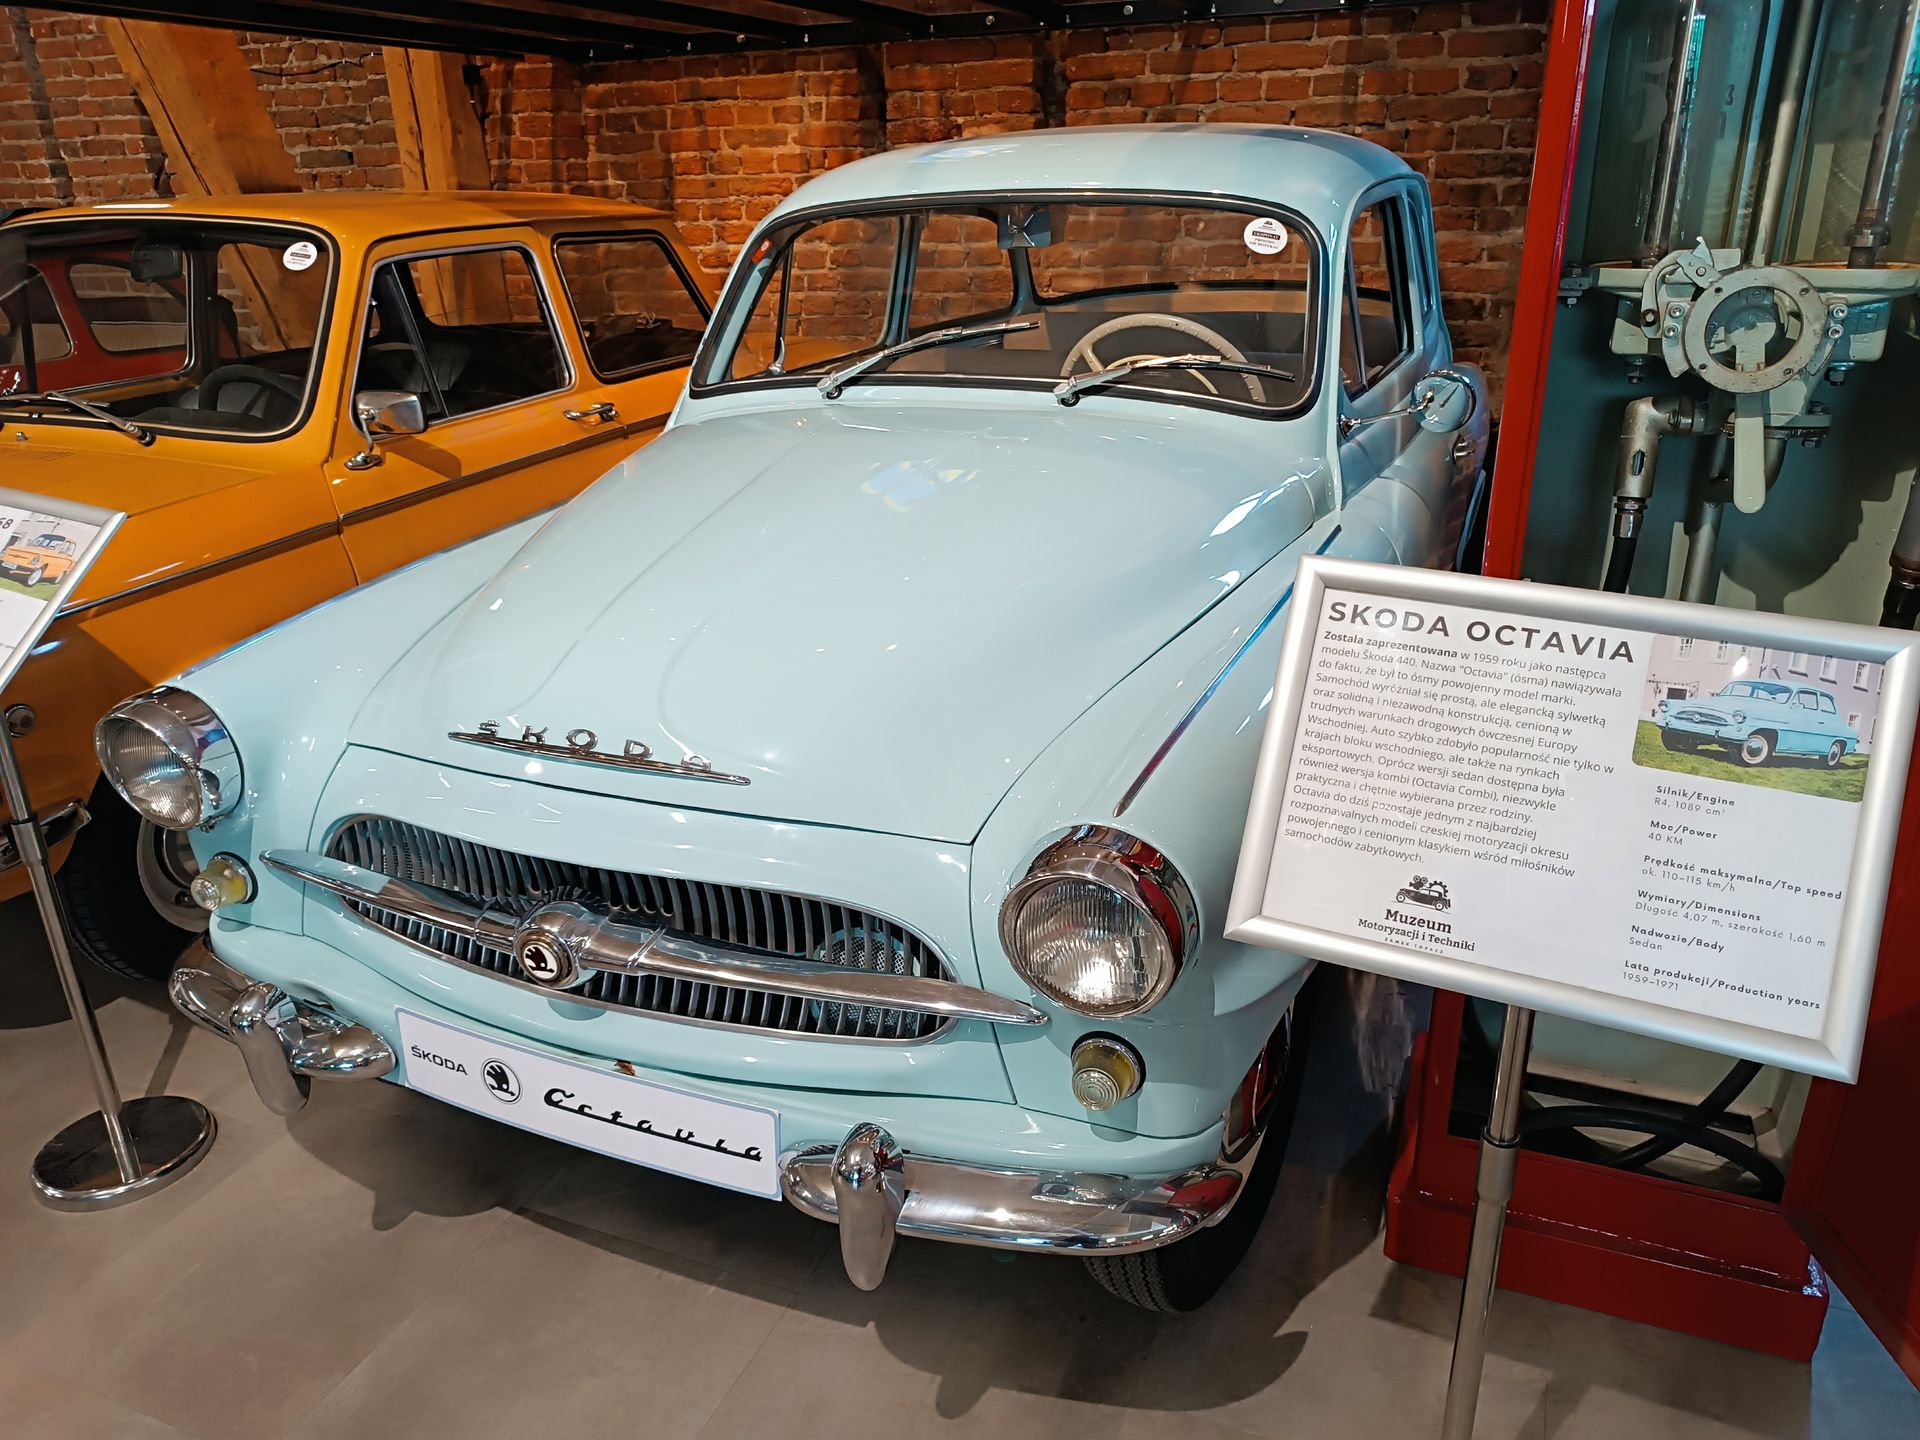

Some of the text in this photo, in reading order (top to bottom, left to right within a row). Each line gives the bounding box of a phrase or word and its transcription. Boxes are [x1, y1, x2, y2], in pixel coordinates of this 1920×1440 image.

[1323, 630, 1606, 680] Została zaprezentowana w 1959 roku jako następca
[1327, 601, 1634, 664] SKODA OCTAVIA
[1318, 658, 1576, 706] do faktu, że był to ósmy powojenny model marki.
[1321, 646, 1360, 659] modelu
[1362, 648, 1394, 664] Škoda
[1396, 656, 1418, 668] 440.
[1420, 659, 1456, 673] Nazwa
[1510, 673, 1549, 688] (ósma)
[1550, 680, 1622, 698] nawiązywała
[1312, 688, 1573, 737] oraz solidną i niezawodną konstrukcją, cenioną w
[1315, 672, 1606, 729] Samochód wyróżniał się prostą, ale elegancką sylwetką
[1307, 714, 1615, 774] Wschodniej. Auto szybko zdobyło popularność nie tylko w
[1310, 701, 1578, 755] trudnych warunkach drogowych ówczesnej Europy
[1301, 742, 1565, 798] eksportowych. Oprócz wersji sedan dostępna była
[1304, 727, 1560, 780] krajach bloku wschodniego, ale także na rynkach
[1295, 772, 1533, 824] praktyczna i chętnie wybierana przez rodziny.
[1298, 756, 1557, 811] również wersja kombi (Octavia Combi), niezwykle
[1654, 797, 1671, 808] R4,
[1675, 800, 1701, 812] 1089
[1656, 785, 1735, 807] Silnik/Engine
[1293, 784, 1537, 841] Octavia do dziś pozostaje jednym z najbardziej
[1650, 820, 1718, 839] Moc/Power
[1284, 828, 1424, 864] samochodów zabytkowych.
[1286, 814, 1576, 878] powojennego i cenionym klasykiem wśród miłośników
[1381, 818, 1418, 831] modeli
[1419, 825, 1462, 842] czeskiej
[1463, 833, 1528, 855] motoryzacji
[1530, 845, 1569, 861] okresu
[1648, 832, 1683, 846] 40 KM
[1641, 866, 1657, 877] ok.
[1706, 877, 1735, 892] km/h
[1643, 854, 1843, 900] Prędkość maksymalna/Top speed
[1384, 908, 1452, 935] Muzeum
[1635, 901, 1678, 917] Długość
[1683, 911, 1708, 923] 4,07
[1711, 919, 1724, 928] m,
[1727, 922, 1784, 939] szerokość
[1789, 932, 1812, 945] 1,60
[1637, 889, 1761, 922] Wymiary/Dimensions
[1357, 918, 1476, 952] Motoryzacji i Techniki
[1628, 936, 1663, 951] Sedan
[1631, 924, 1725, 953] Nadwozie/Body
[1624, 959, 1820, 1009] Lata produkcji/Production years
[411, 1044, 468, 1076] ŠKODA
